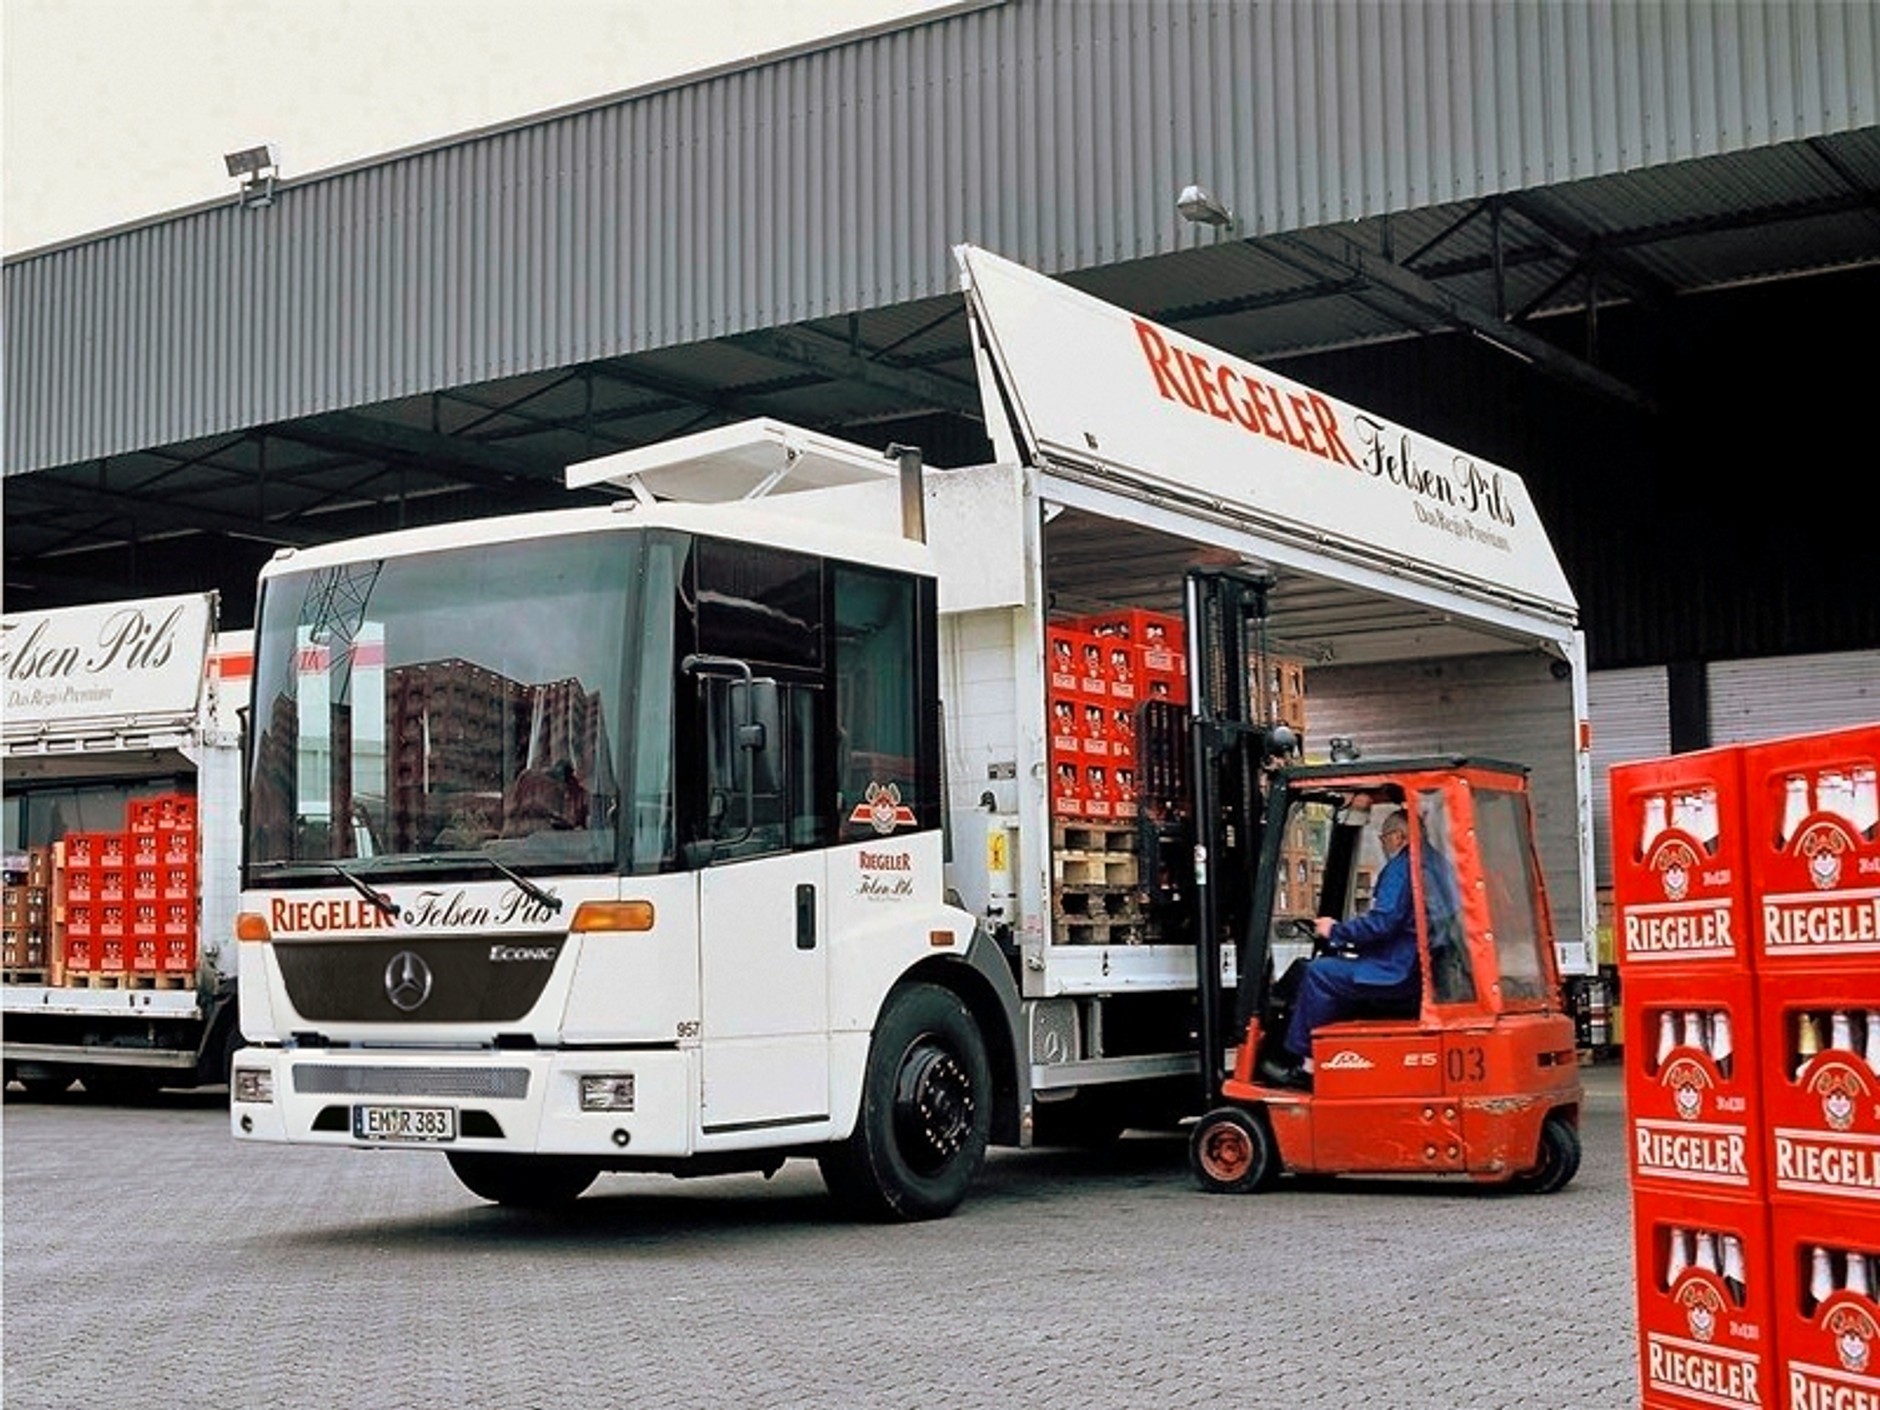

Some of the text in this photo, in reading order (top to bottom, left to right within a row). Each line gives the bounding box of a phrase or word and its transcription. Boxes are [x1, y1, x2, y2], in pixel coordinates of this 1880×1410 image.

[1131, 318, 1515, 527] RIEGELER Felsen Pils
[86, 604, 185, 673] Pils
[859, 850, 911, 871] RIEGELER
[271, 893, 396, 932] RIEGELER
[410, 890, 489, 928] Felsen
[1624, 908, 1734, 952] RIEGELER
[677, 1021, 700, 1038] 957
[1447, 1047, 1486, 1082] 03
[416, 1111, 446, 1134] 383
[1635, 1127, 1747, 1174] RIEGELER
[1648, 1341, 1761, 1403] RIEGELER
